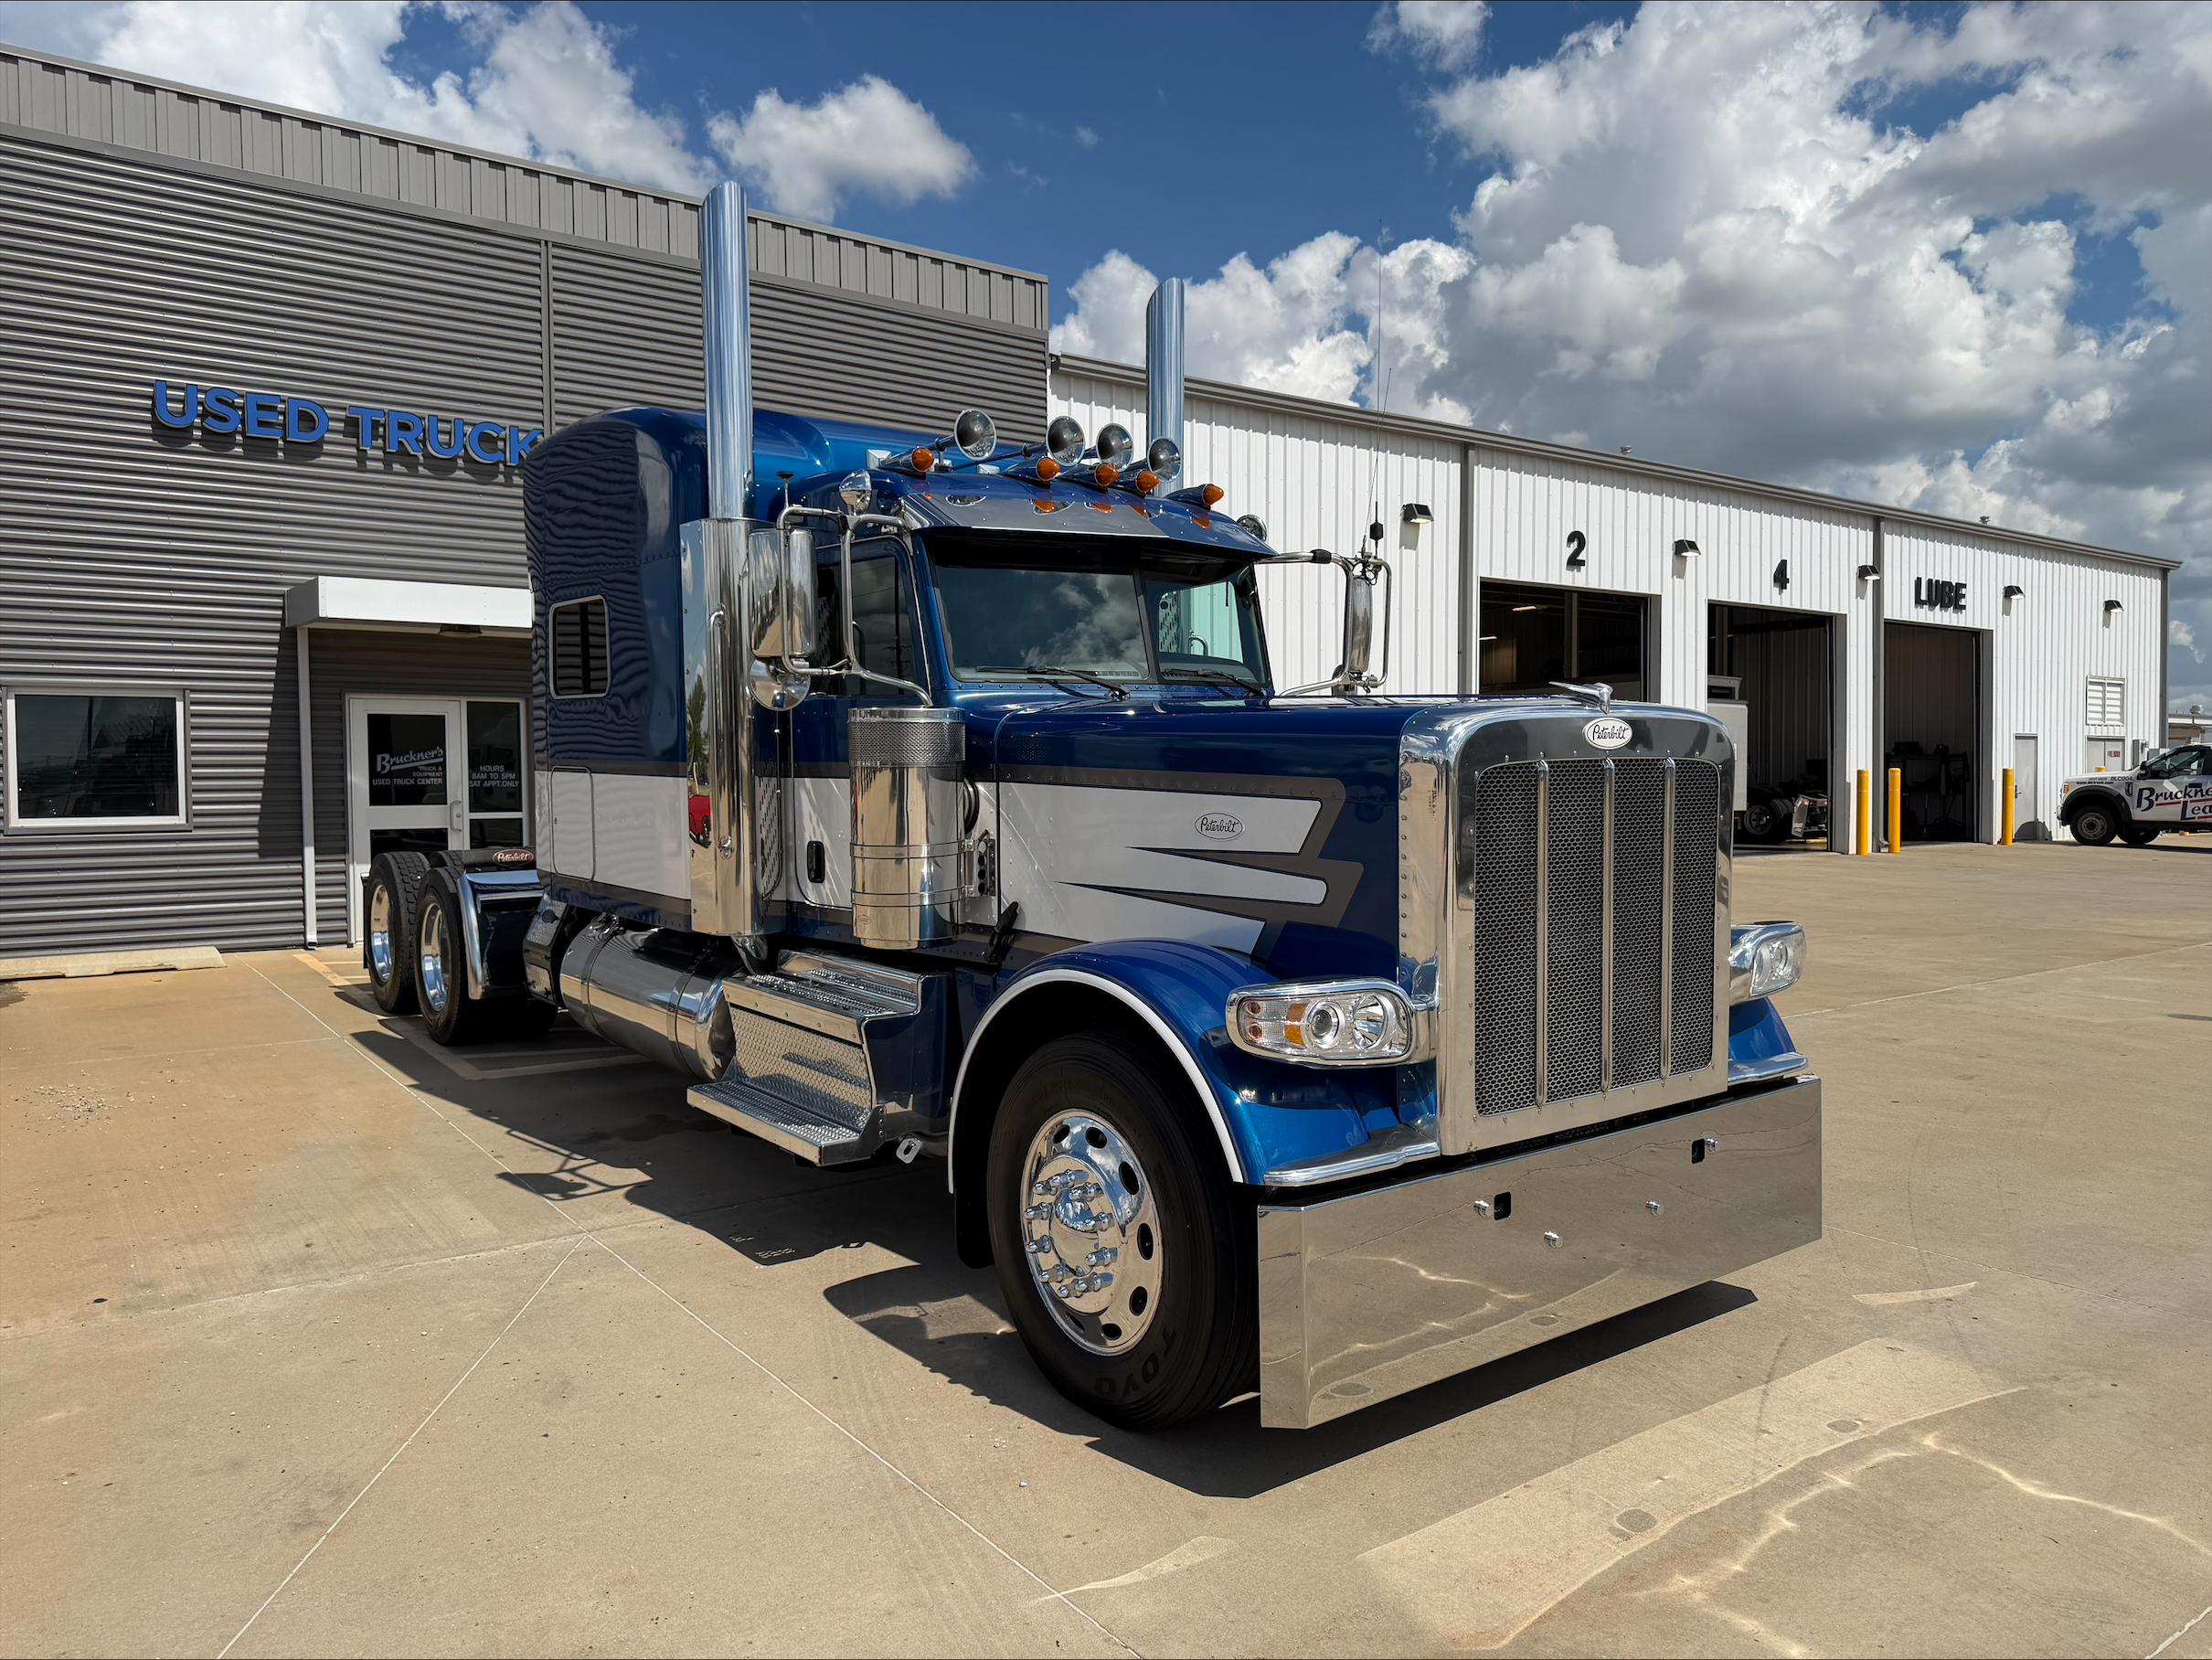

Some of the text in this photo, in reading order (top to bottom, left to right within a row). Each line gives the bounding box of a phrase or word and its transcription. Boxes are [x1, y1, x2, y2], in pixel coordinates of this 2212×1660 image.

[154, 379, 544, 466] USED TRUCK
[1567, 530, 1586, 567] 2
[1773, 559, 1790, 590] 4
[1915, 576, 1967, 611] LUBE
[1592, 724, 1629, 740] Peterbilt
[377, 746, 444, 774] Bruckner's
[480, 764, 505, 772] HOURS
[469, 780, 482, 788] SAT
[1200, 817, 1239, 833] Peterbilt
[498, 852, 531, 863] Peterbilt
[1094, 1325, 1177, 1398] TOYO
